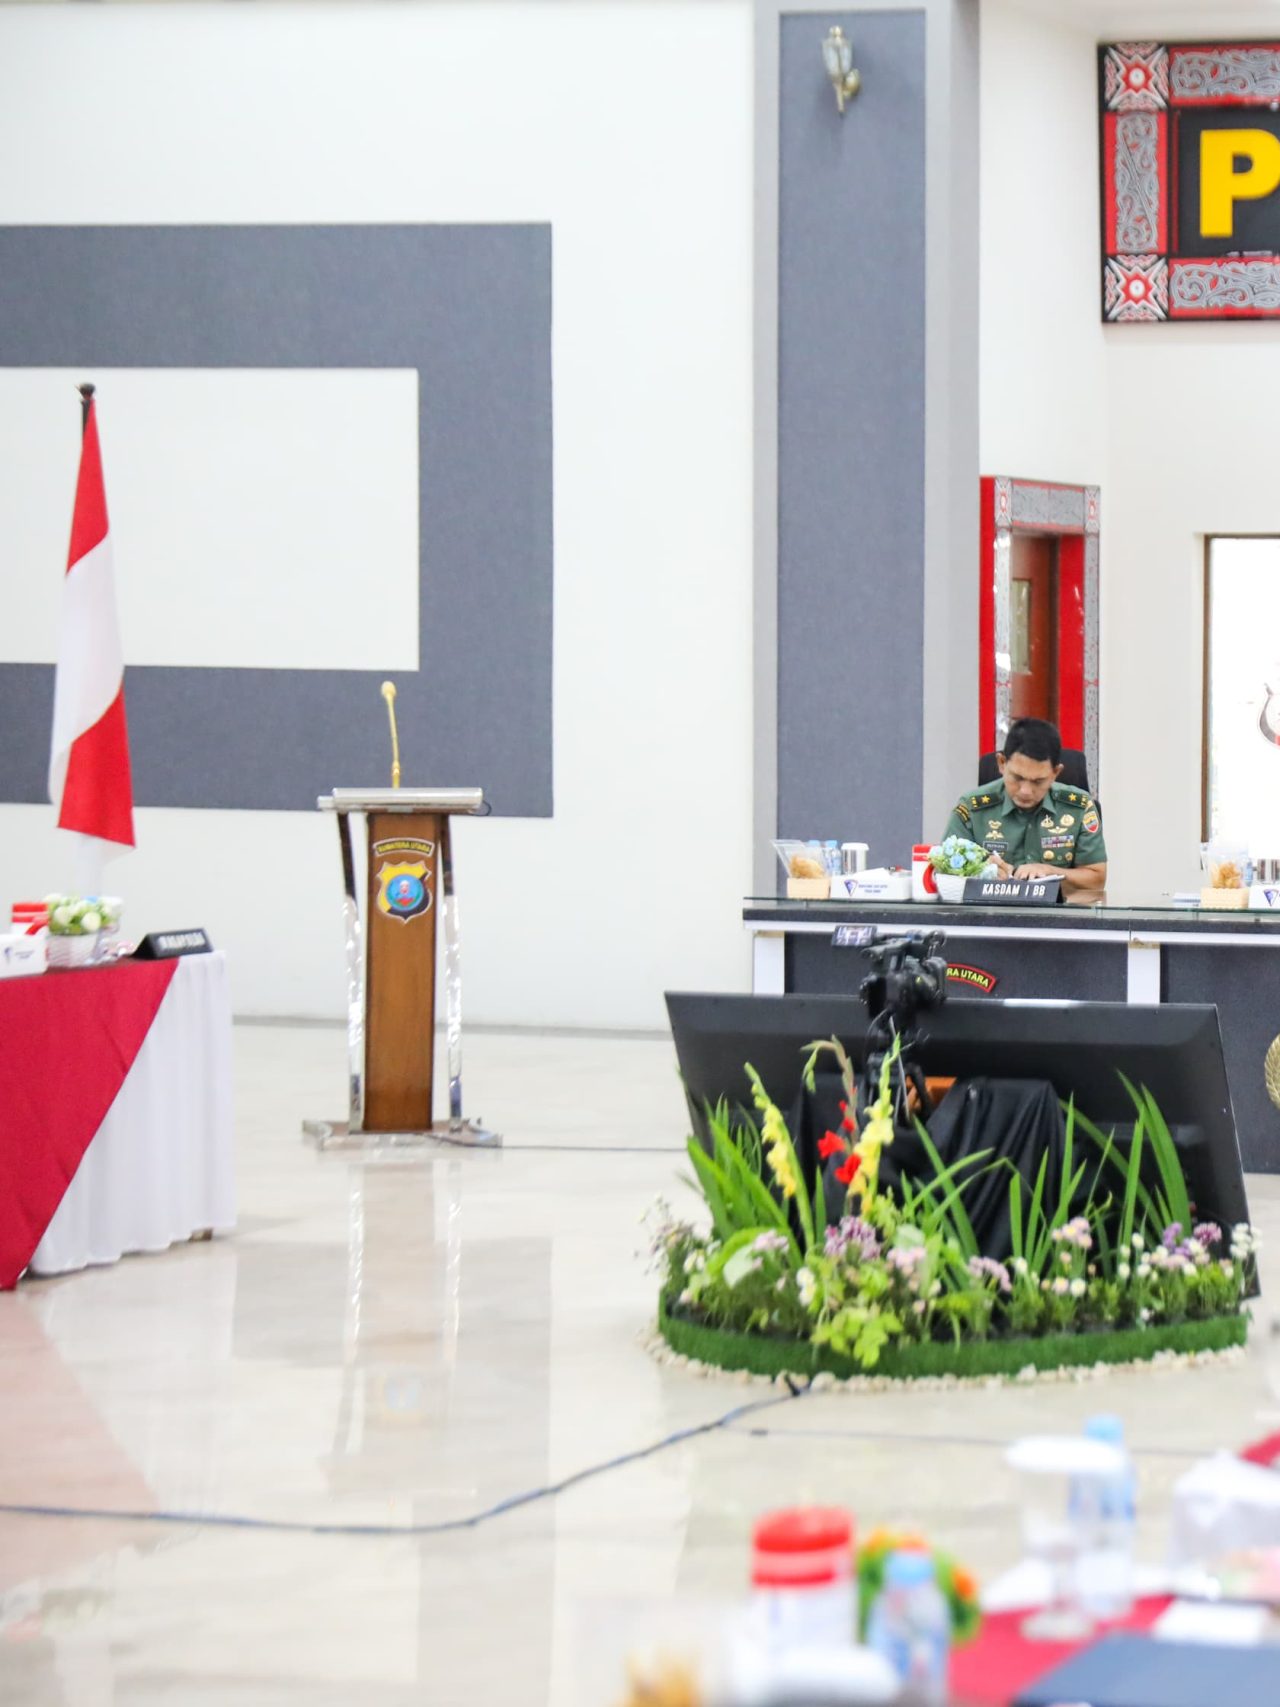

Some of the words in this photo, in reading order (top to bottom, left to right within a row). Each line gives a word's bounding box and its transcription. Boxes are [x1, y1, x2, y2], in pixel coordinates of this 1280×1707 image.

[982, 883, 1020, 896] KASDAM
[1032, 884, 1046, 897] BB
[960, 969, 989, 988] UTARA
